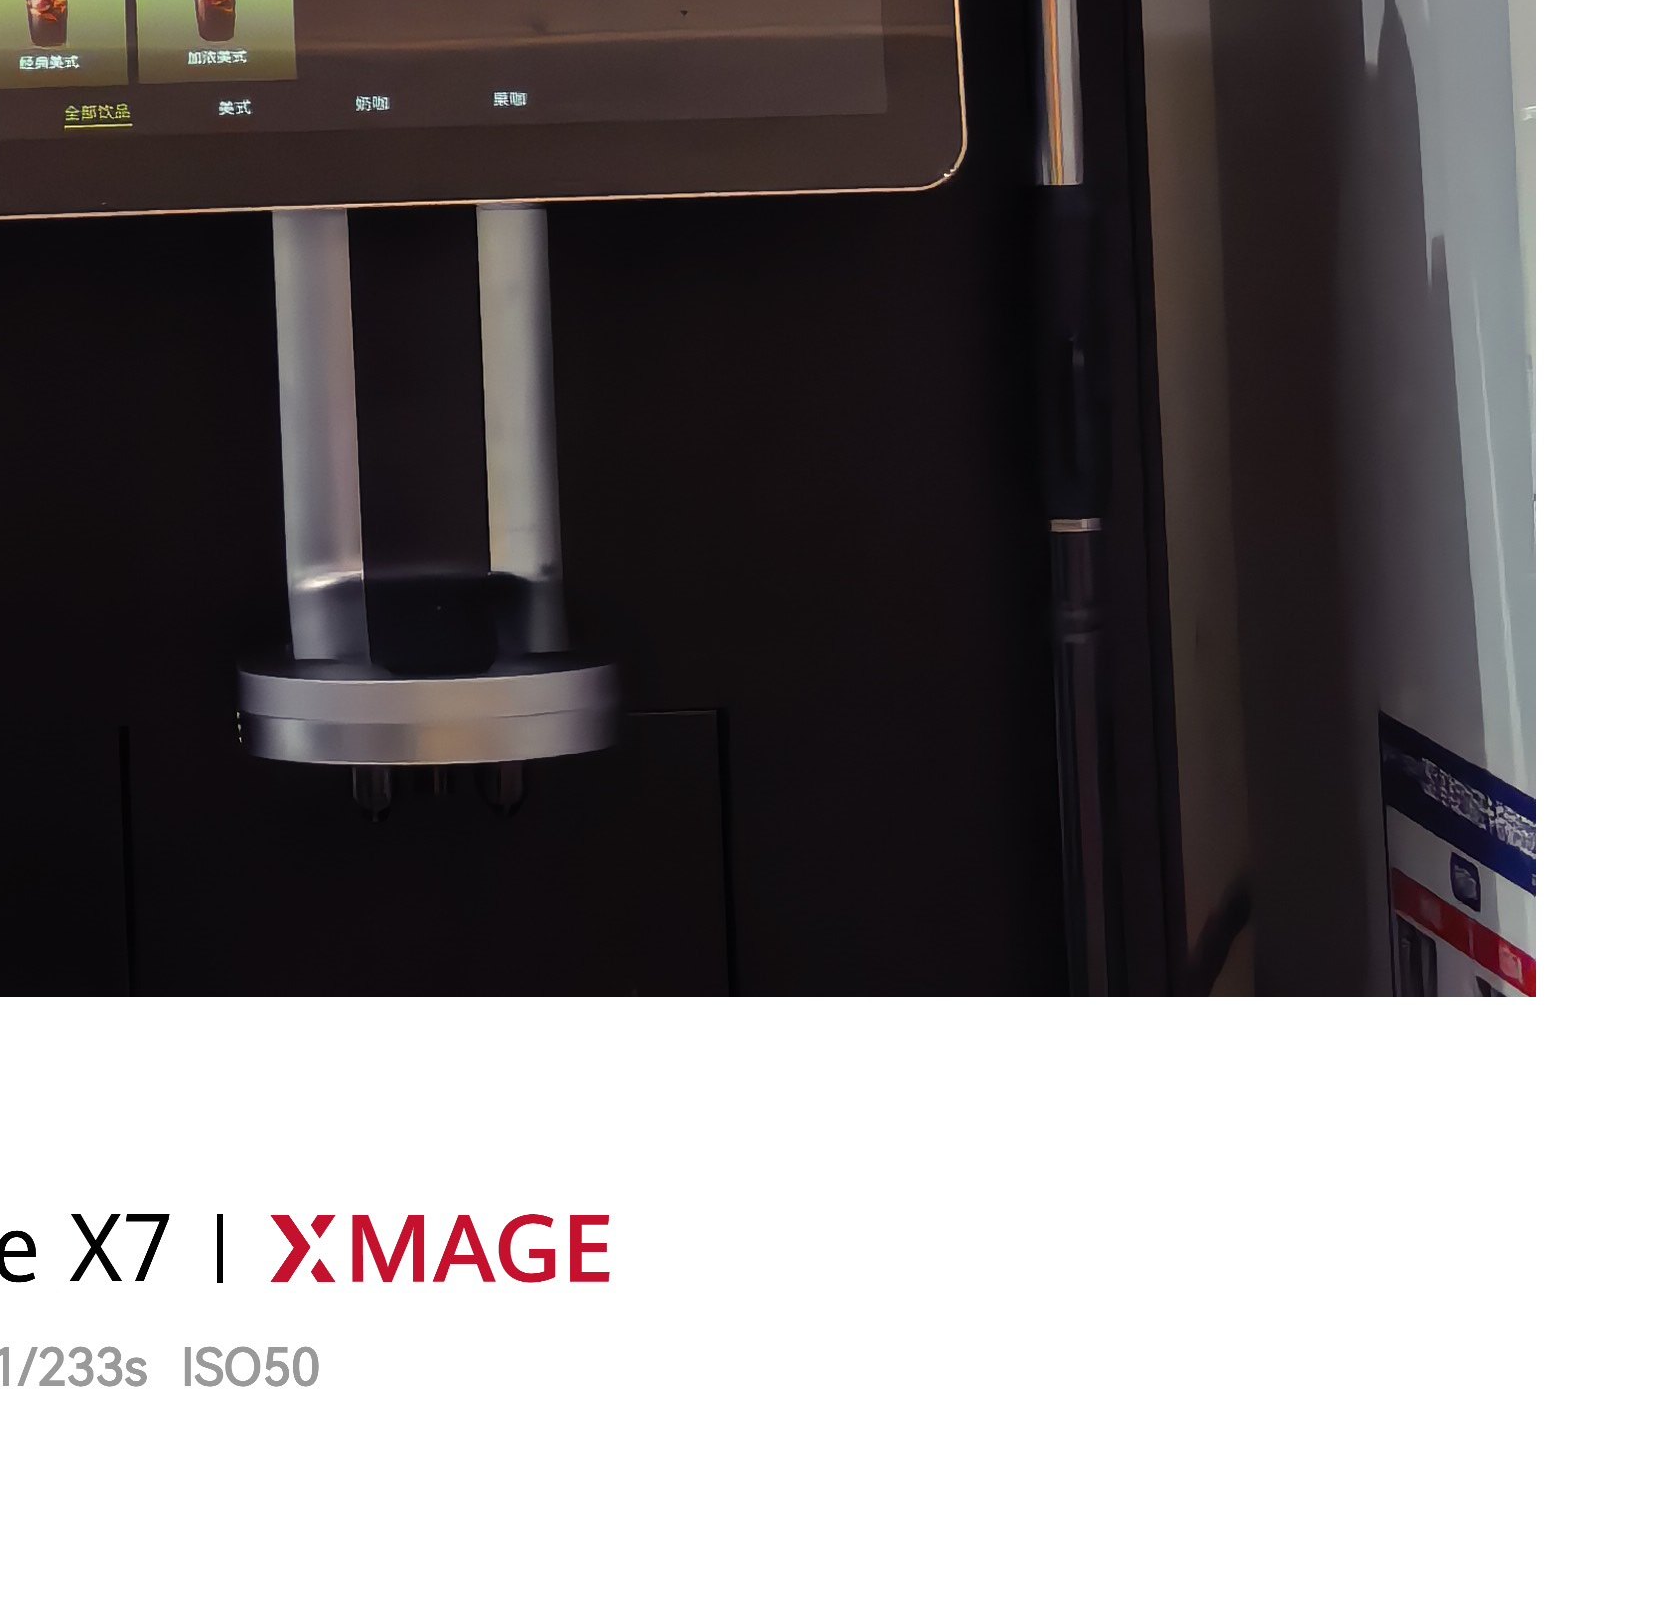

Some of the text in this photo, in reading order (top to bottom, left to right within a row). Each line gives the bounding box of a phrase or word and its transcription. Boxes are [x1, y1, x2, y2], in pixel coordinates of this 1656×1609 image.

[64, 103, 131, 121] 全部饮品
[218, 99, 252, 116] 美式
[355, 95, 391, 112] 奶咖
